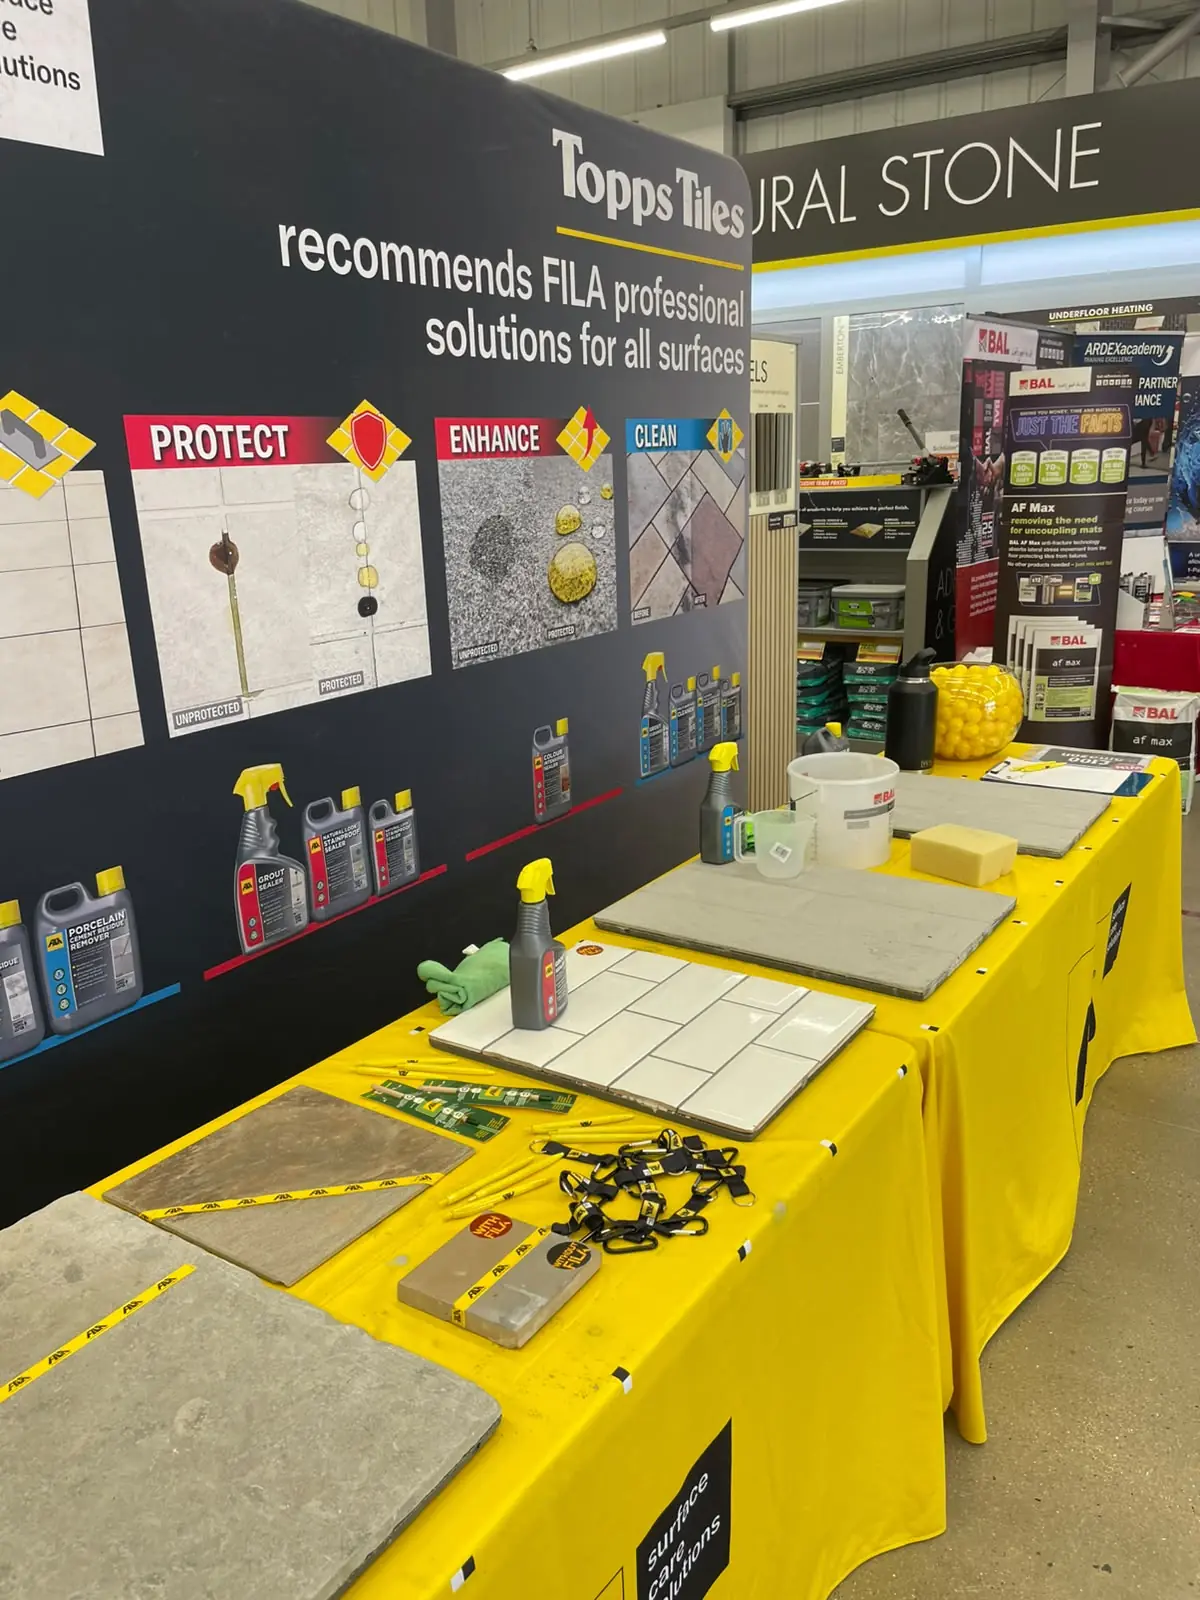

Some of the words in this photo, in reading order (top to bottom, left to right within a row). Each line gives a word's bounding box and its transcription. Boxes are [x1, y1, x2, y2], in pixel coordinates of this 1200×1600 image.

[0, 55, 80, 91] utions
[878, 121, 1102, 217] STONE
[552, 128, 674, 226] Topps
[675, 167, 745, 239] Tiles
[278, 223, 533, 301] recommends
[543, 255, 607, 310] FILA
[614, 276, 744, 328] professional
[1049, 308, 1110, 320] UNDERFLOOR
[1111, 303, 1154, 316] HEATING
[425, 308, 572, 365] solutions
[580, 320, 617, 367] for
[624, 328, 651, 370] all
[658, 334, 745, 375] surfaces
[988, 331, 1009, 355] BAL
[1084, 342, 1165, 358] ARDEXacademy
[1030, 378, 1055, 389] BAL
[1138, 376, 1178, 390] PARTNER
[1016, 415, 1049, 436] JUST
[1050, 414, 1080, 434] THE
[1080, 413, 1124, 434] FACTS
[150, 424, 289, 461] PROTECT
[450, 424, 540, 454] ENHANCE
[634, 424, 678, 448] CLEAN
[1011, 502, 1026, 512] AF
[1029, 502, 1056, 512] Max
[1011, 517, 1052, 526] removing
[1075, 516, 1098, 524] need
[1024, 526, 1077, 535] uncoupling
[548, 626, 574, 638] PROTECTED
[1062, 636, 1086, 646] BAL
[458, 643, 498, 662] UNPROTECTED
[1052, 658, 1062, 667] af
[321, 673, 362, 692] PROTECTED
[175, 702, 240, 726] UNPROTECTED
[1147, 706, 1178, 720] BAL
[1133, 735, 1147, 744] af
[1150, 738, 1173, 746] max
[543, 748, 563, 761] COLOUR
[323, 828, 344, 840] NATURAL
[344, 824, 358, 834] LOOK
[323, 829, 360, 848] STAINPROOF
[324, 840, 346, 853] SEALER
[258, 868, 285, 884] GROUT
[258, 878, 284, 892] SEALER
[68, 911, 125, 938] PORCELAIN
[70, 930, 96, 944] CEMENT
[98, 920, 125, 935] RESIDUE
[70, 932, 110, 951] REMOVER
[474, 1215, 500, 1236] WITH
[484, 1220, 511, 1239] FILA
[554, 1241, 577, 1268] WITHOUT
[563, 1247, 592, 1270] FILA
[648, 1472, 708, 1572] surface
[663, 1514, 722, 1600] lutions
[648, 1540, 686, 1600] care
